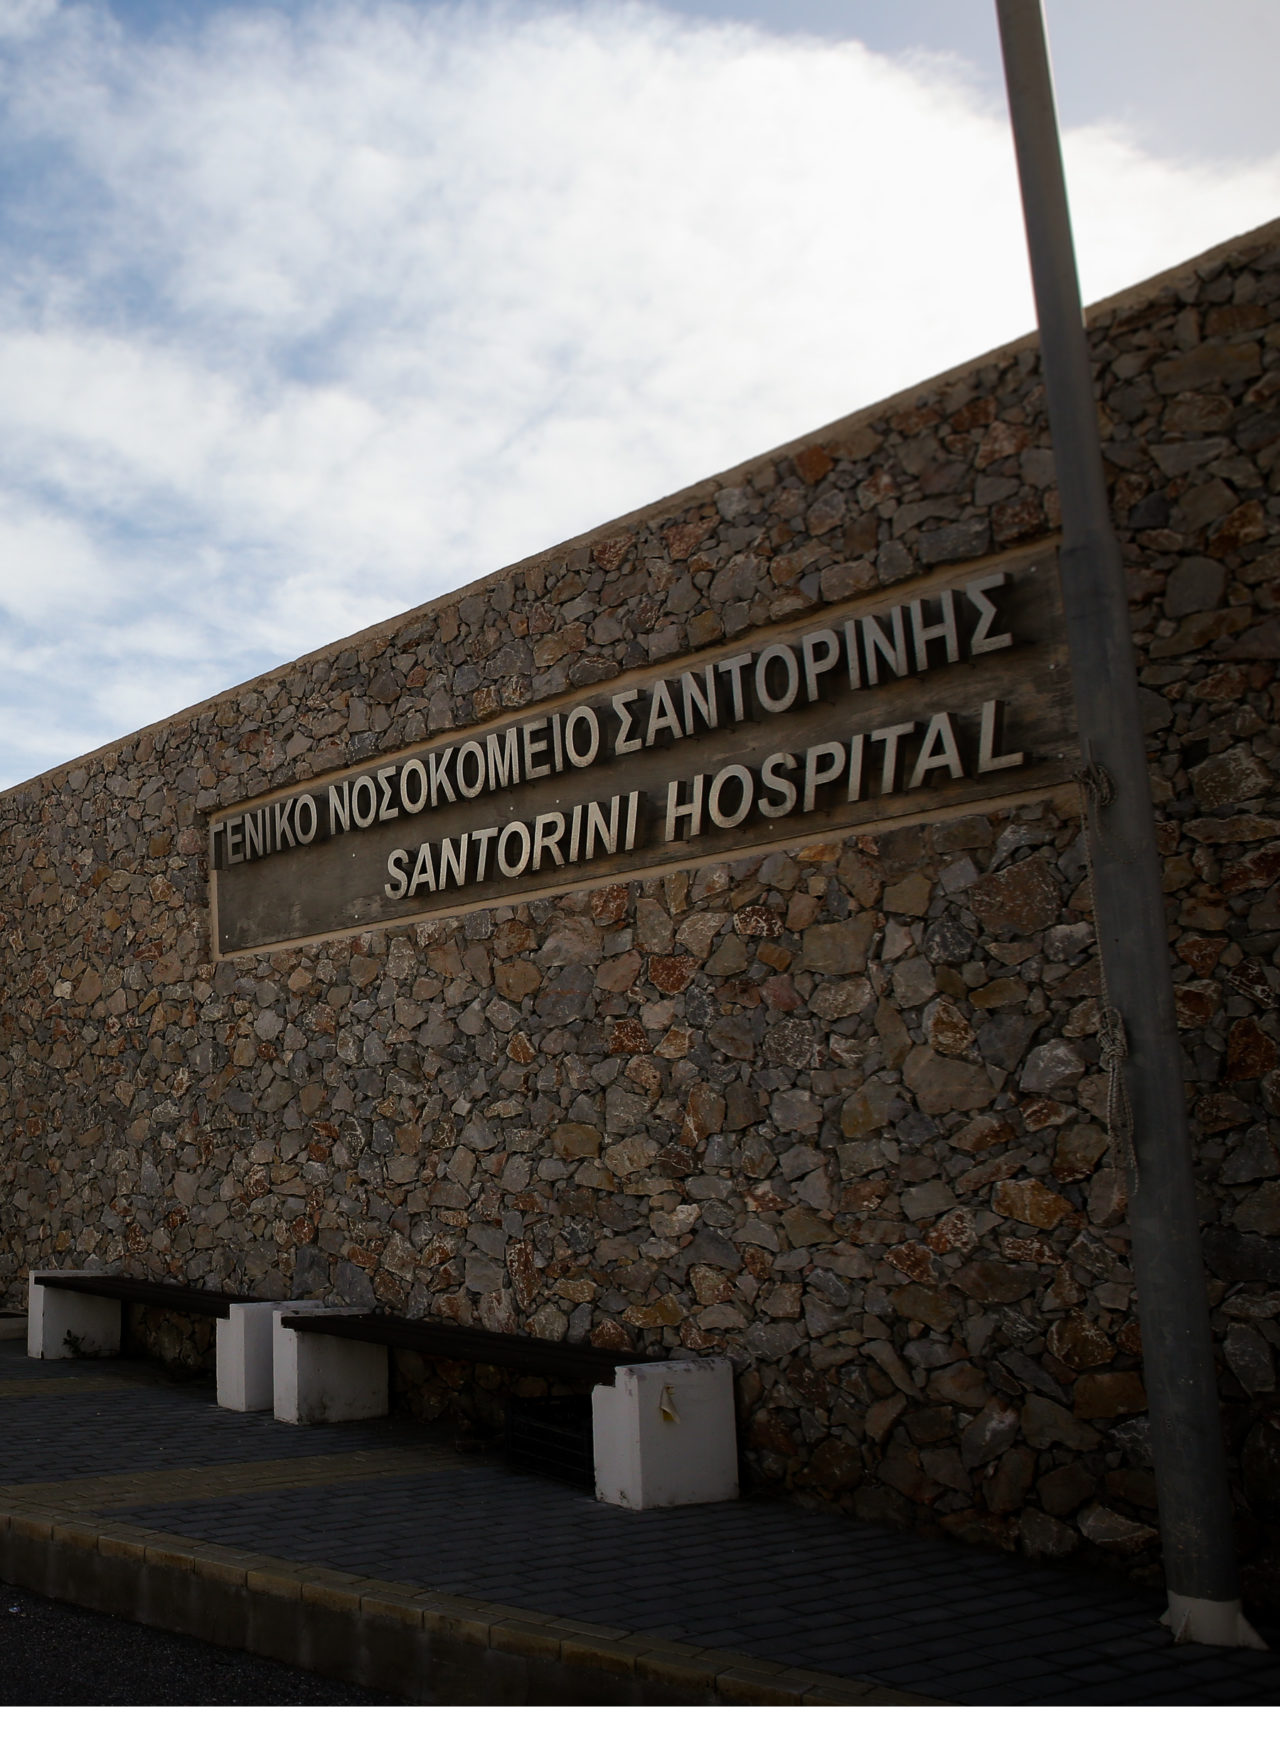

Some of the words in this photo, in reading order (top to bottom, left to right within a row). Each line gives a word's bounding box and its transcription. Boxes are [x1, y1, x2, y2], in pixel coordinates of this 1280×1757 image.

[209, 794, 318, 870] ΓΕΝΙΚΟ
[328, 705, 600, 835] ΝΟΣΟΚΟΜΕΙΟ
[611, 572, 1014, 756] ΣΑΝΤΟΡΙΝΗΣ
[384, 790, 643, 900] SANTORINI
[664, 700, 1025, 842] HOSPITAL
